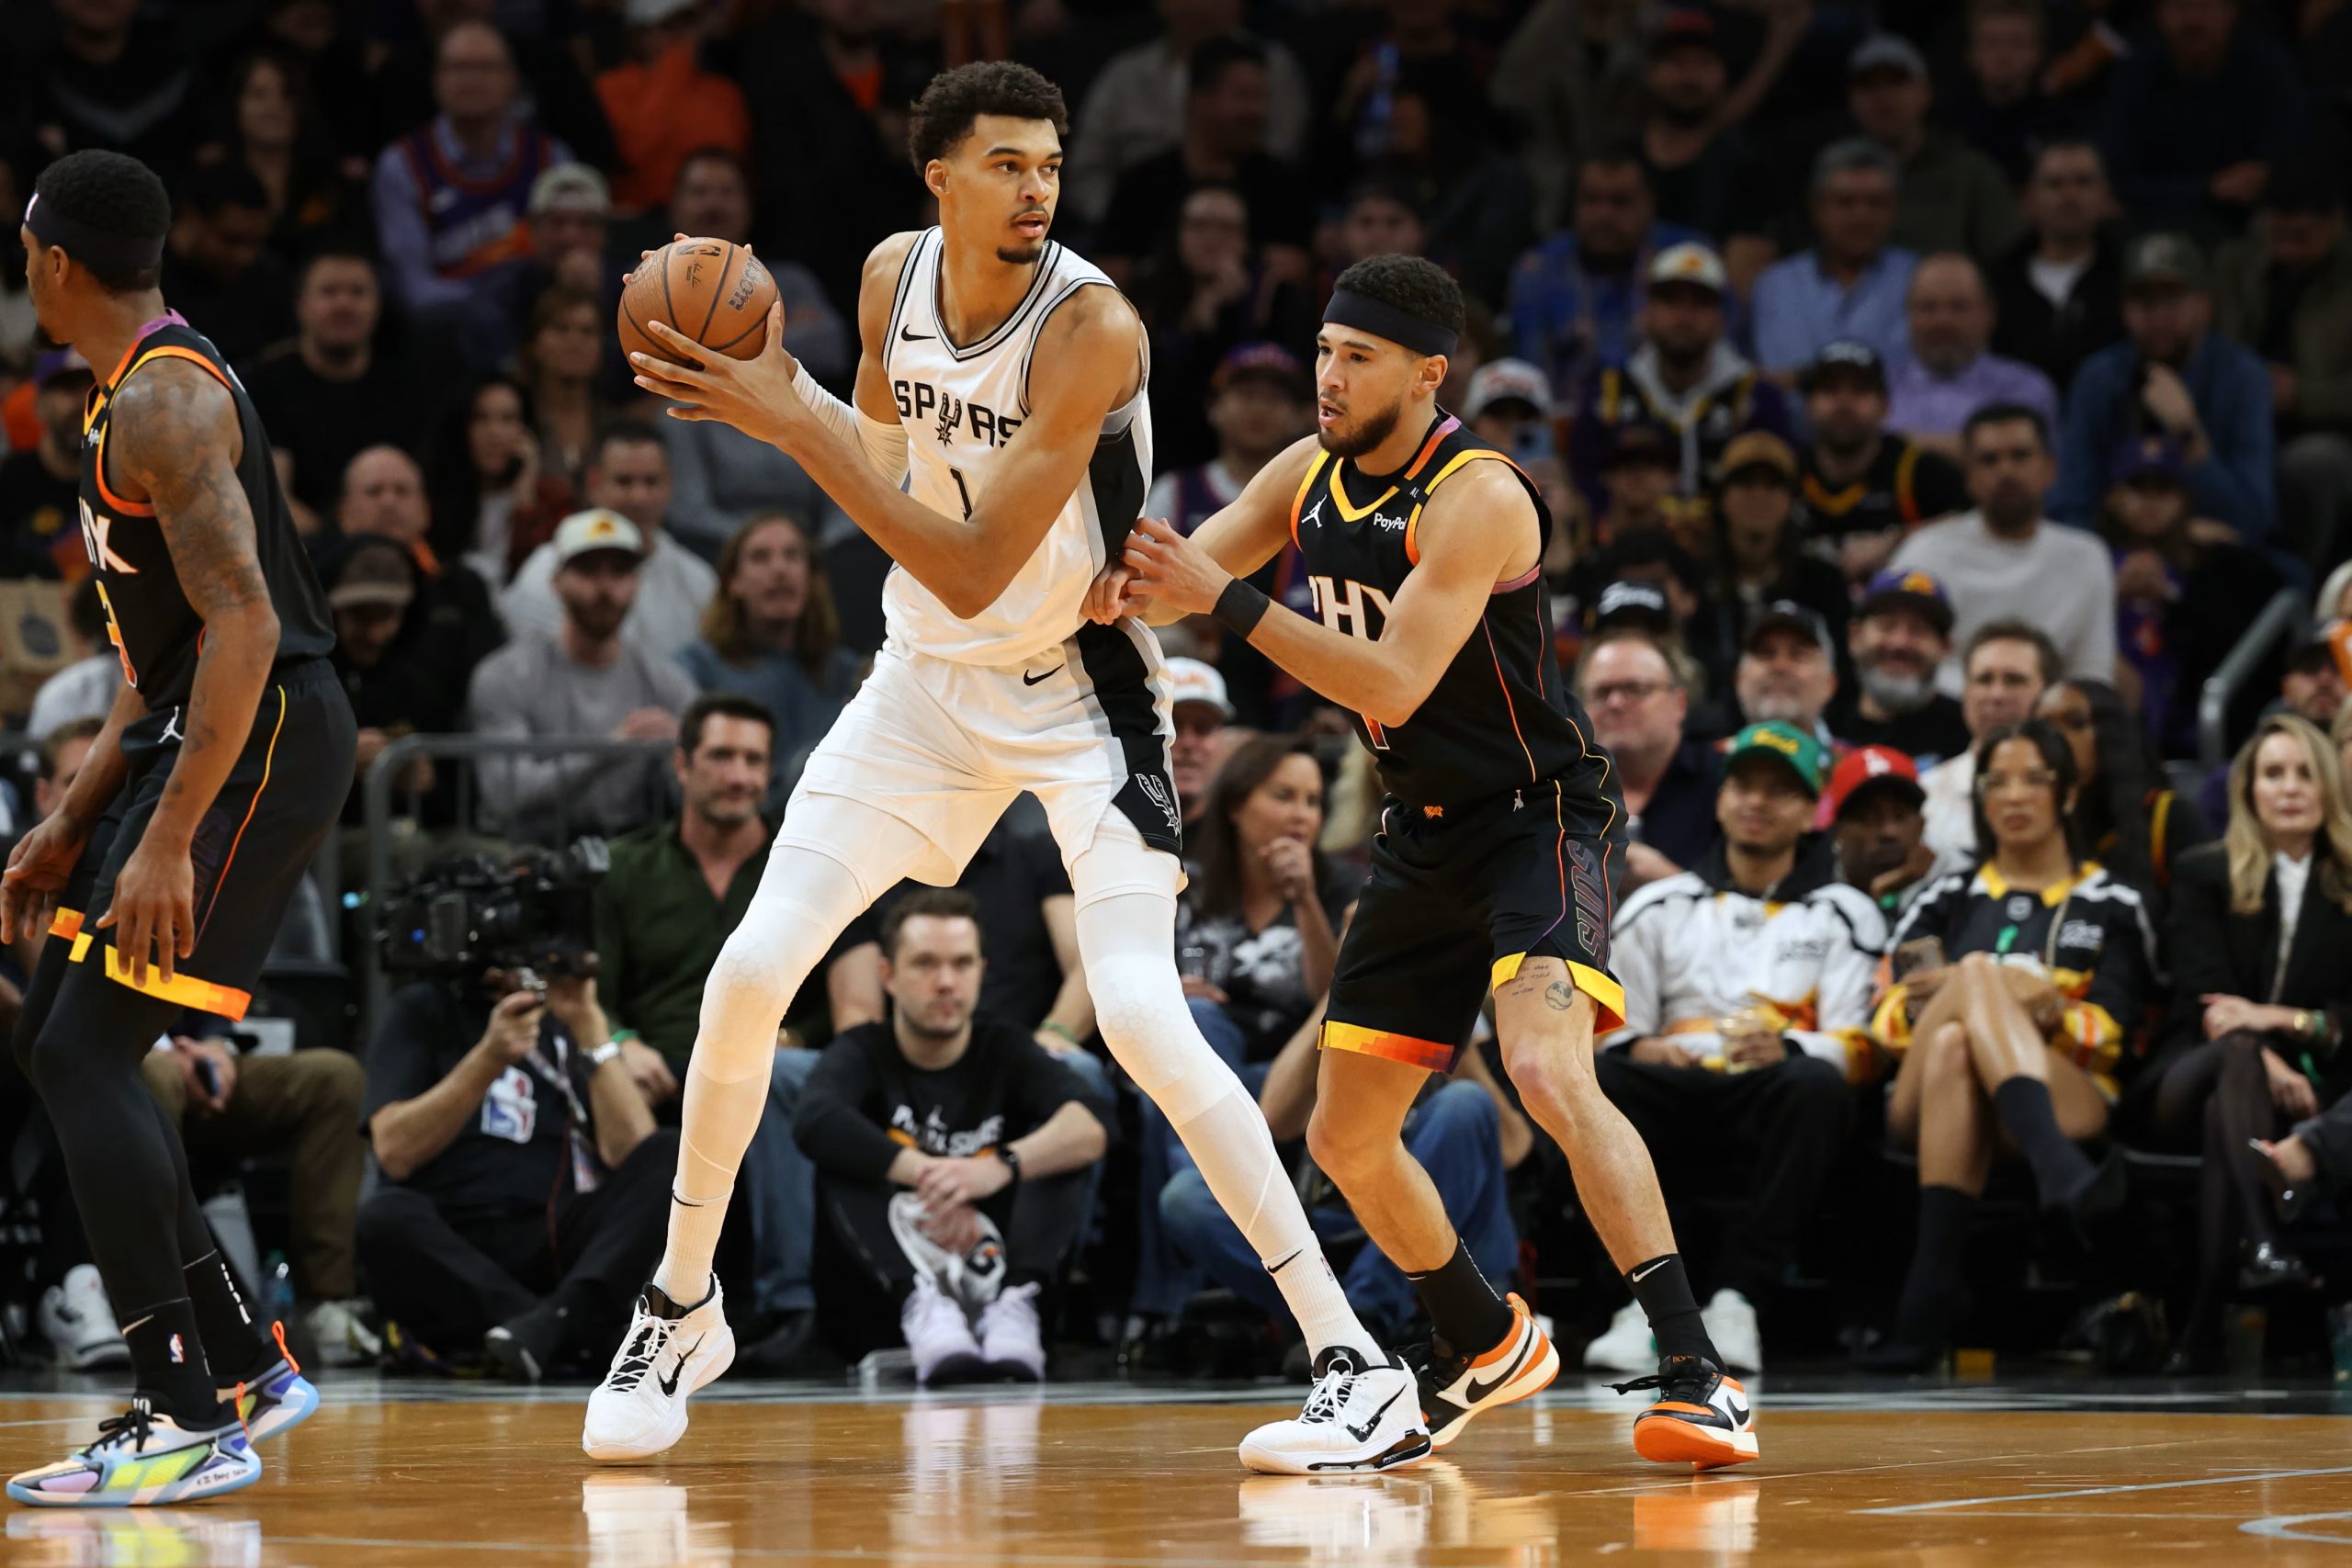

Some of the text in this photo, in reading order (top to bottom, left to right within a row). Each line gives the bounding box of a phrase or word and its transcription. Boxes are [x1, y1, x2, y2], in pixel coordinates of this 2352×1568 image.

[729, 256, 770, 311] ilson
[948, 464, 974, 522] 1
[1409, 487, 1419, 498] AL
[1373, 512, 1408, 532] PayPal
[1566, 840, 1608, 969] SUNS
